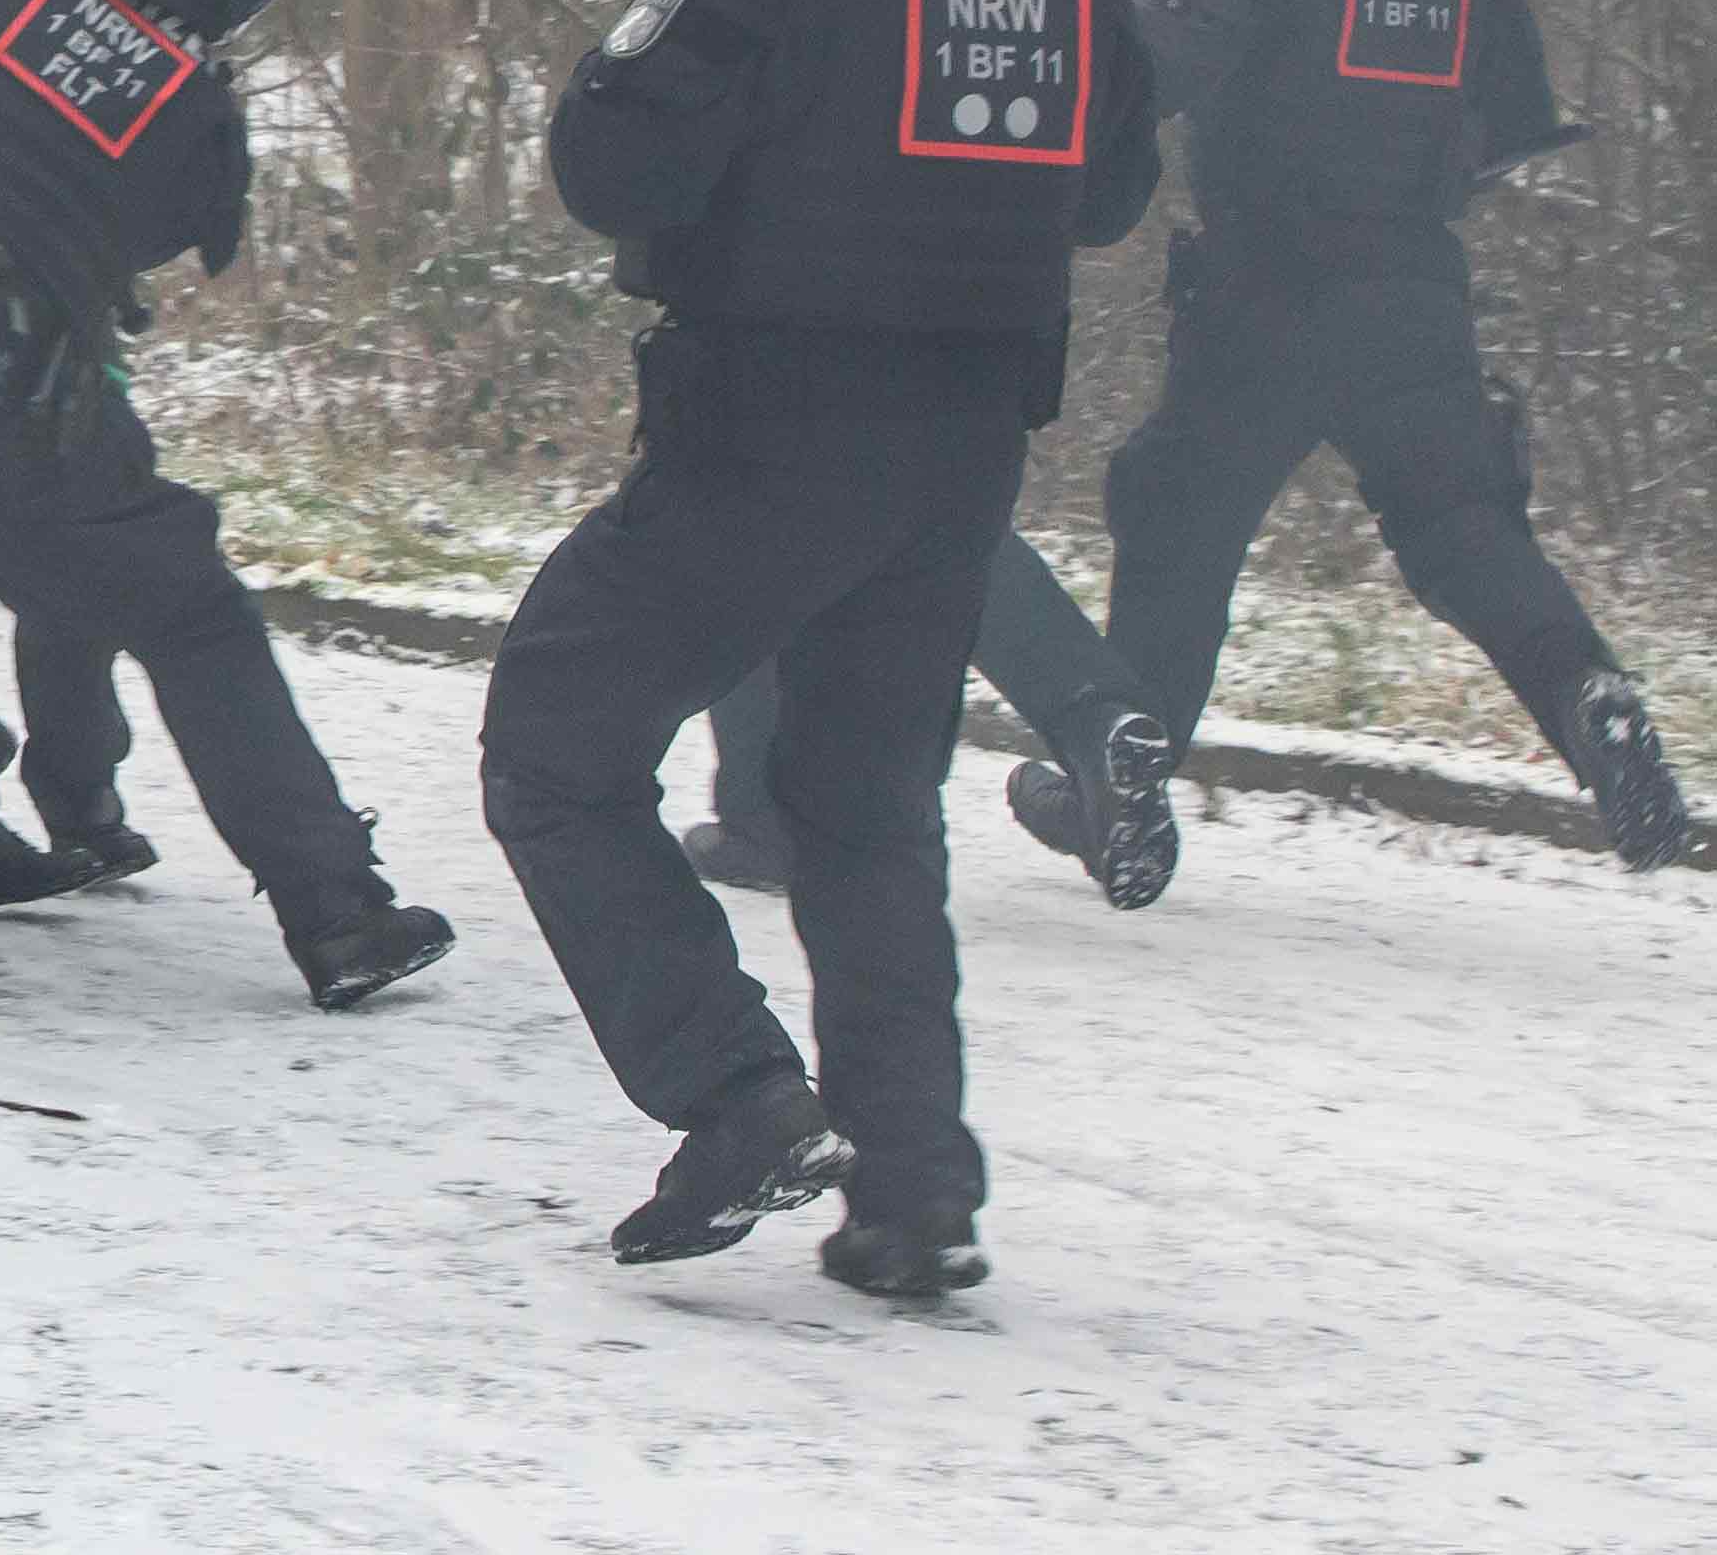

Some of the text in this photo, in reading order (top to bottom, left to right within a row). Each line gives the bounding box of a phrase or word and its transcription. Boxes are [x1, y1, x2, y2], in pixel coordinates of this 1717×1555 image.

[1364, 0, 1450, 30] 1 BF 11
[40, 52, 109, 107] FLT
[46, 14, 147, 99] 1 BF 11
[935, 42, 1063, 84] 1 BF 11
